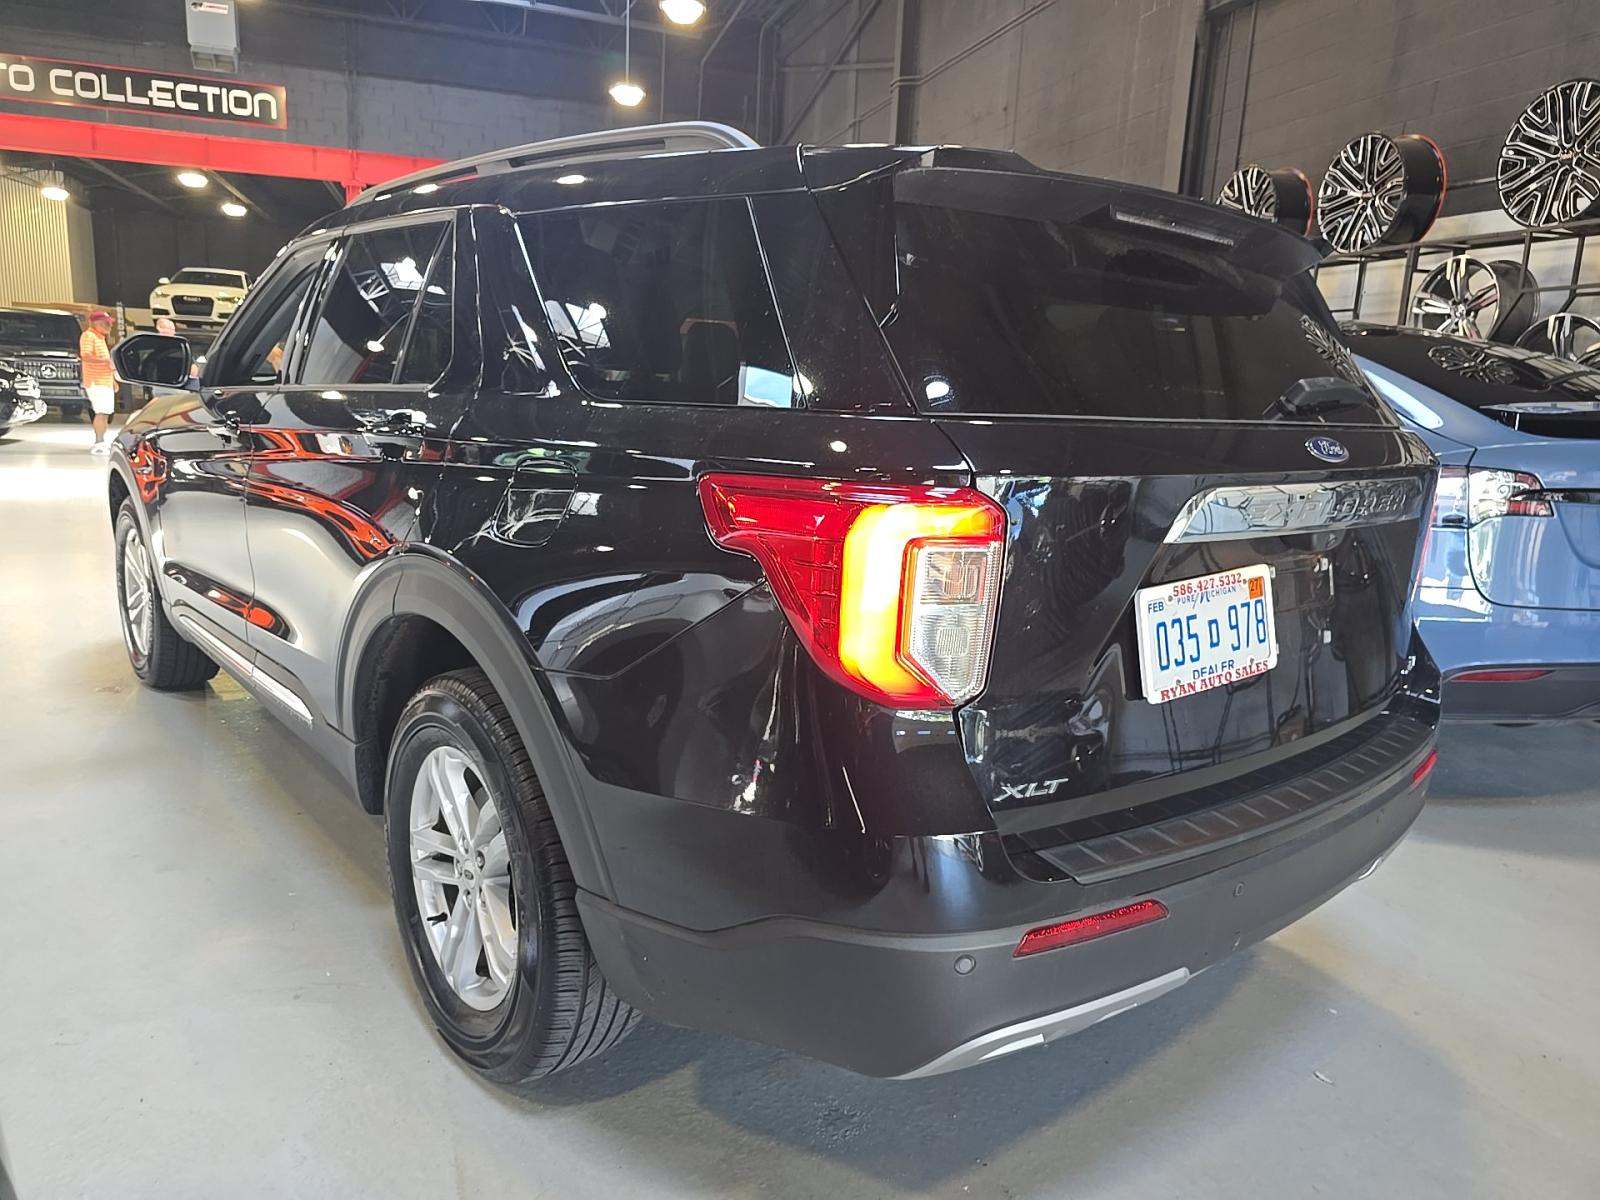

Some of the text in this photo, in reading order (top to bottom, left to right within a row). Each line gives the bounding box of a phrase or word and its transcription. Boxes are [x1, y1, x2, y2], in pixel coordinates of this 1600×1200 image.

[0, 63, 278, 120] O COLLECTION
[1173, 572, 1242, 597] 586.427.5332
[1147, 601, 1165, 614] FEB
[1156, 598, 1267, 671] 035 D 978
[1160, 660, 1269, 701] RYAN AUTO SALES
[1192, 659, 1235, 680] DEALER
[993, 778, 1069, 802] XLT
